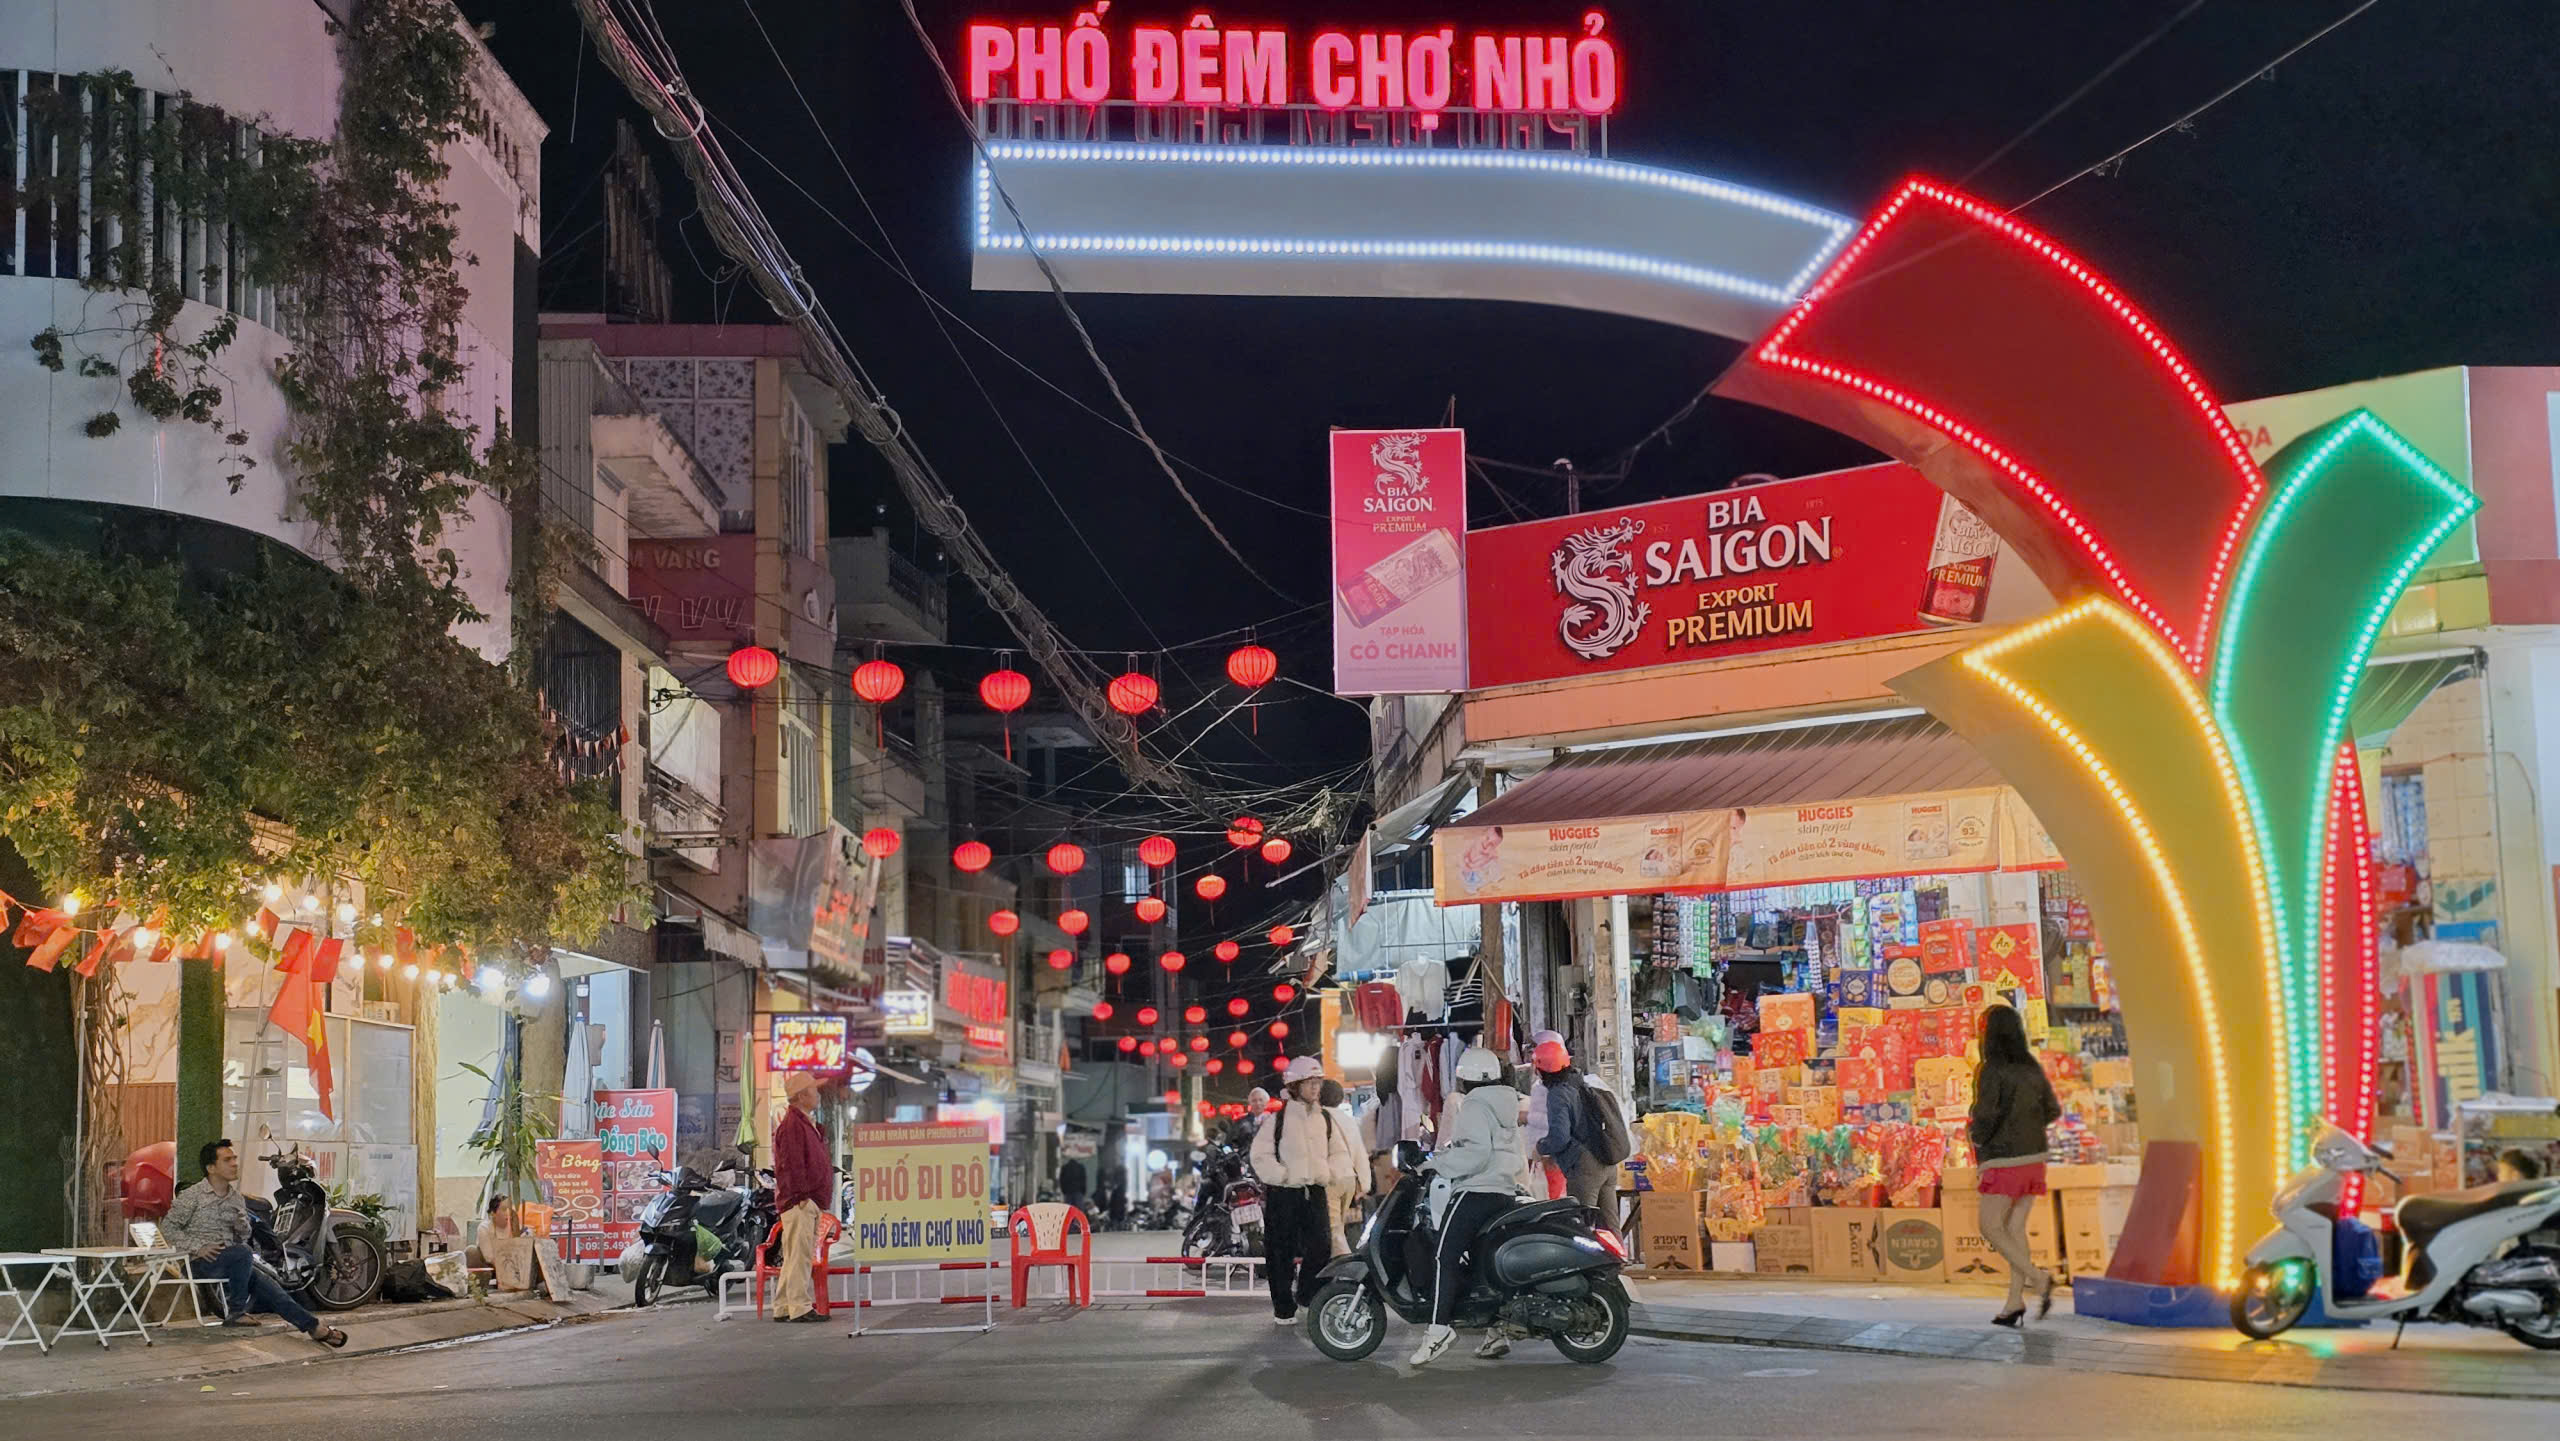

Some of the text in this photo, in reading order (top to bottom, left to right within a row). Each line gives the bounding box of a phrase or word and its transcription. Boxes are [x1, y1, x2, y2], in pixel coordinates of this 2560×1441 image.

[970, 1, 1110, 100] PHỐ
[1132, 14, 1287, 104] ĐÊM
[1313, 29, 1453, 130] CHỢ
[1474, 12, 1616, 112] NHỎ
[1387, 487, 1409, 496] BIA
[1363, 497, 1433, 512] SAIGON
[1708, 495, 1766, 529] BIA
[1373, 523, 1427, 532] PREMIUM
[1645, 516, 1832, 586] SAIGON
[1932, 568, 1987, 588] PREMIUM
[1698, 583, 1779, 609] EXPORT
[1402, 624, 1425, 635] HÓA
[1667, 600, 1814, 647] PREMIUM
[1350, 640, 1457, 660] CÔ CHANH
[1797, 806, 1854, 822] HUGGIES
[1549, 826, 1600, 841] HUGGIES
[1798, 825, 1819, 834] skin
[1828, 837, 1836, 848] 2
[1576, 855, 1583, 866] 2
[561, 1154, 601, 1173] Bông
[859, 1153, 985, 1206] PHỐ ĐI BỘ
[860, 1210, 985, 1252] PHỐ ĐÊM CHỢ NHỎ
[1890, 1237, 1938, 1249] CRAVEN
